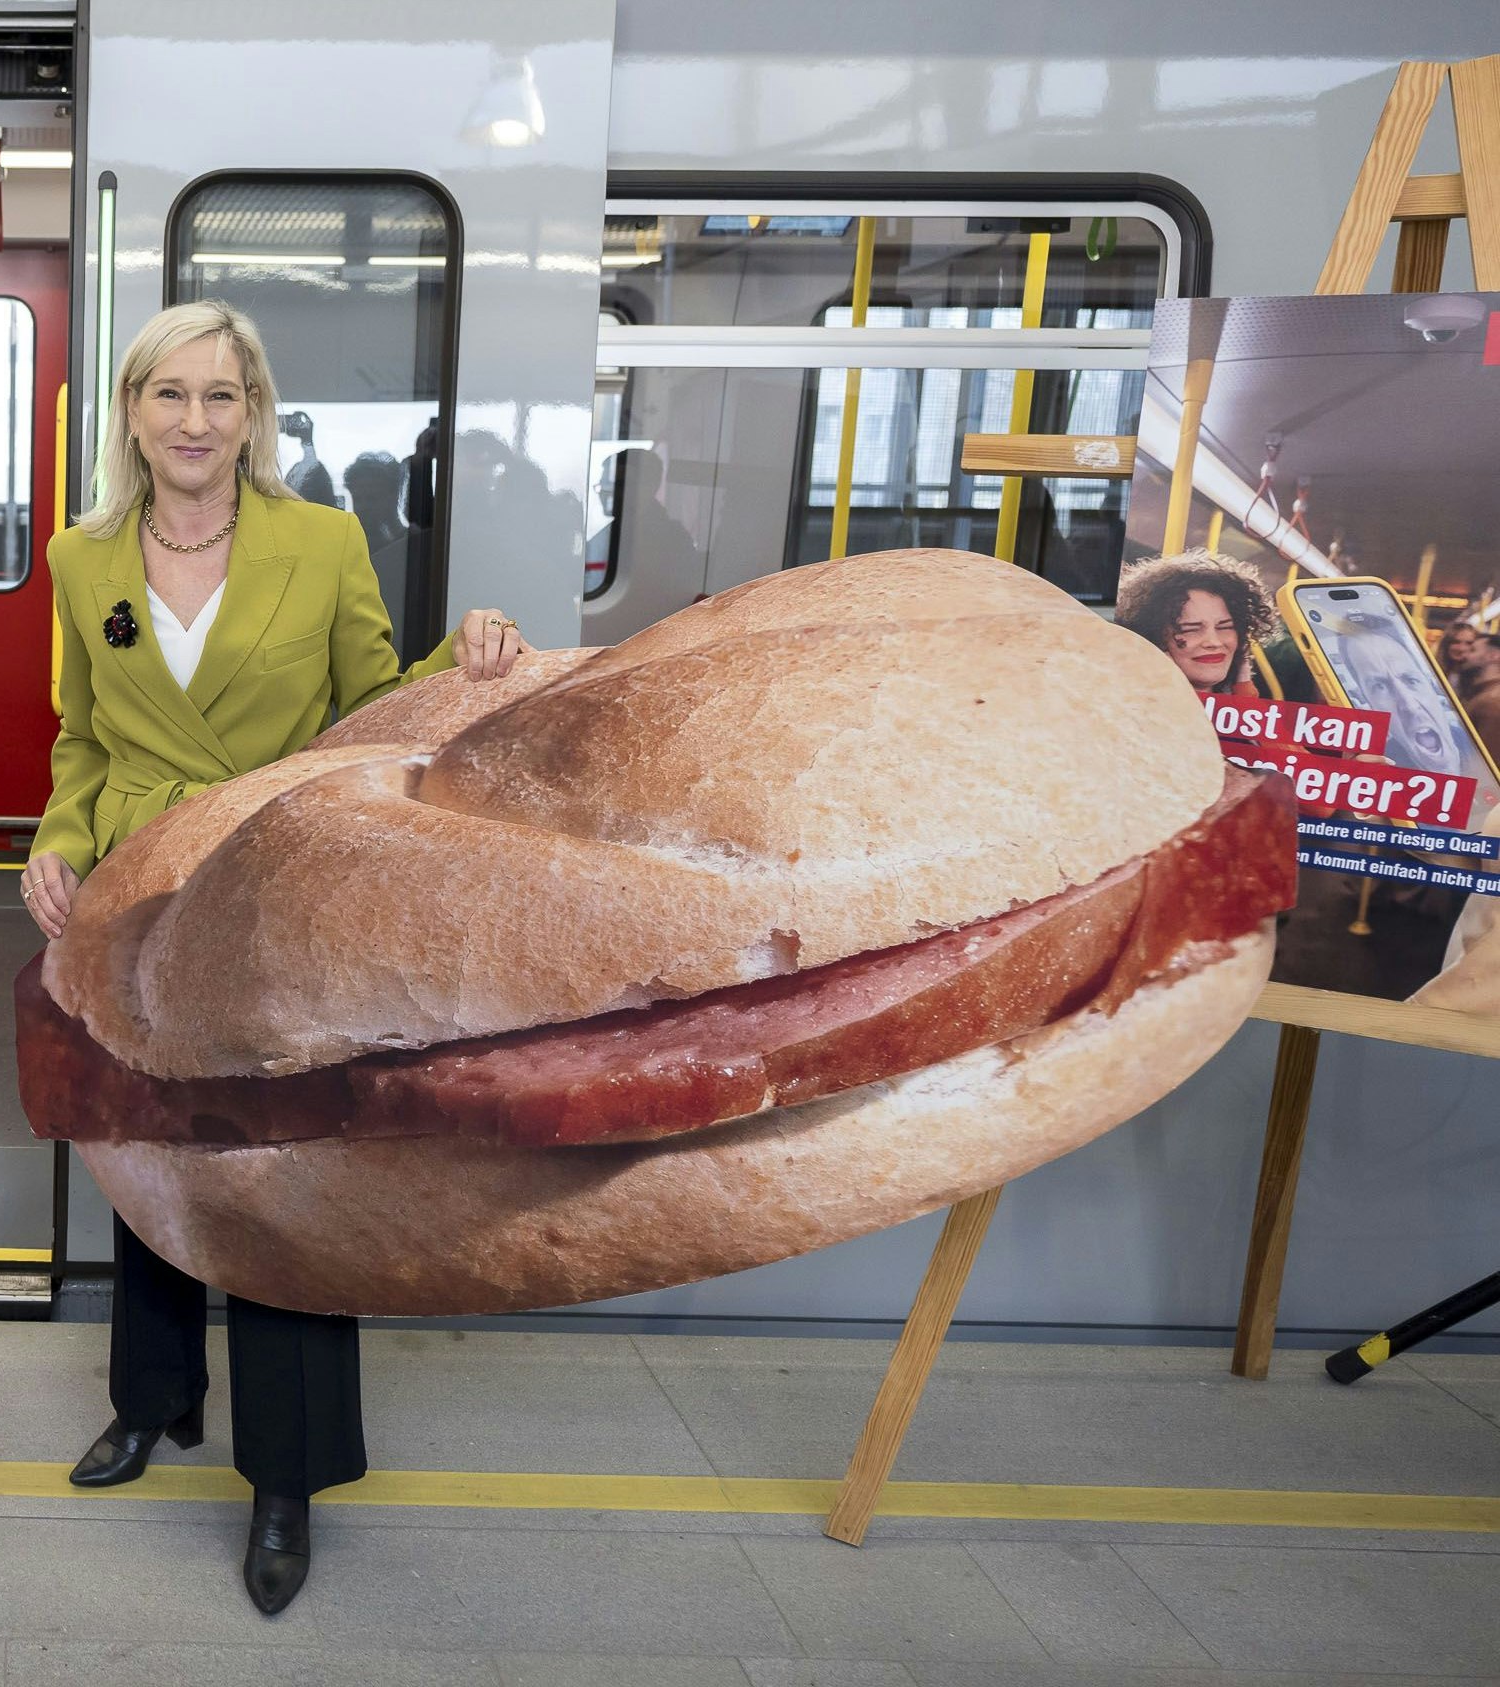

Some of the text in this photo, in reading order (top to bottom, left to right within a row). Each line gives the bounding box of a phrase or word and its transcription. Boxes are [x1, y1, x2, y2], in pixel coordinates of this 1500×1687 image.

[1293, 706, 1373, 751] kan
[1297, 822, 1492, 855] andere eine riesige Qual:
[1313, 851, 1367, 872] kommt
[1369, 861, 1428, 881] einfach
[1431, 870, 1474, 888] nicht
